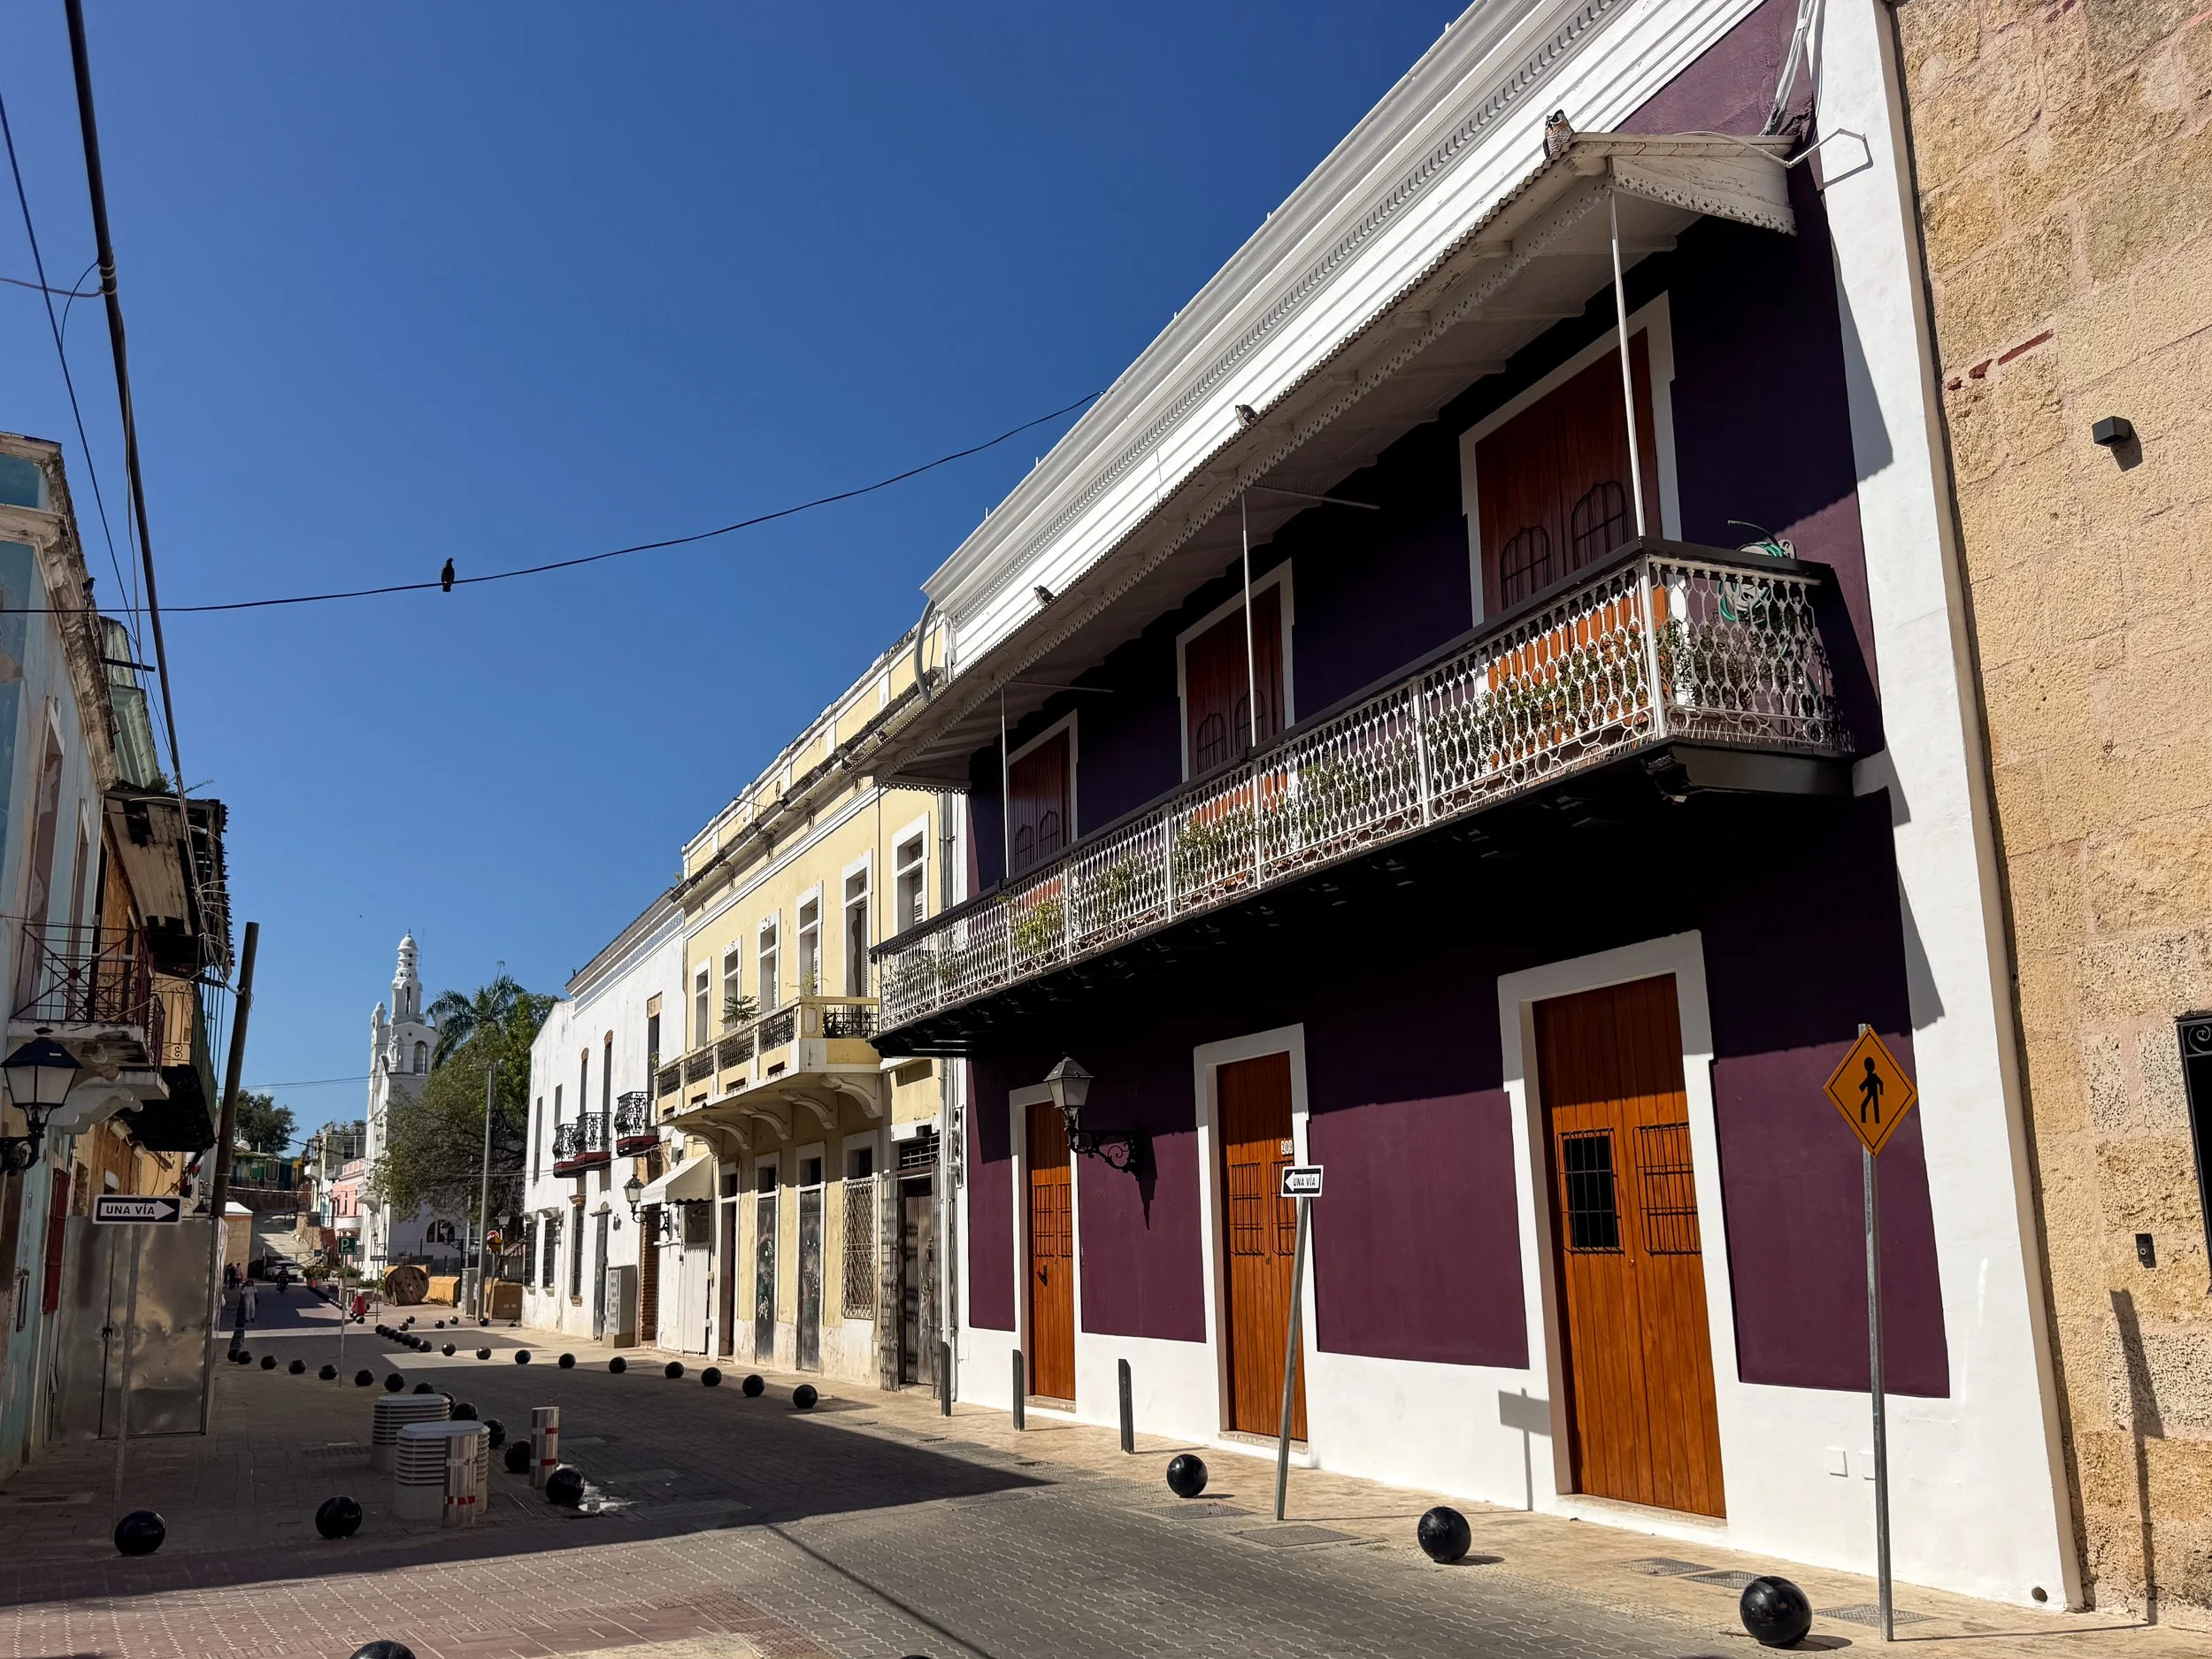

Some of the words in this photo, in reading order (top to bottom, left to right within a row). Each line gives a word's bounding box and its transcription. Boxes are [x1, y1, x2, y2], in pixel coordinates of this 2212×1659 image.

[1293, 1177, 1305, 1187] UNA
[1305, 1174, 1316, 1187] VÍA
[106, 1205, 130, 1215] UNA
[135, 1203, 155, 1215] VÍA
[341, 1239, 349, 1252] P
